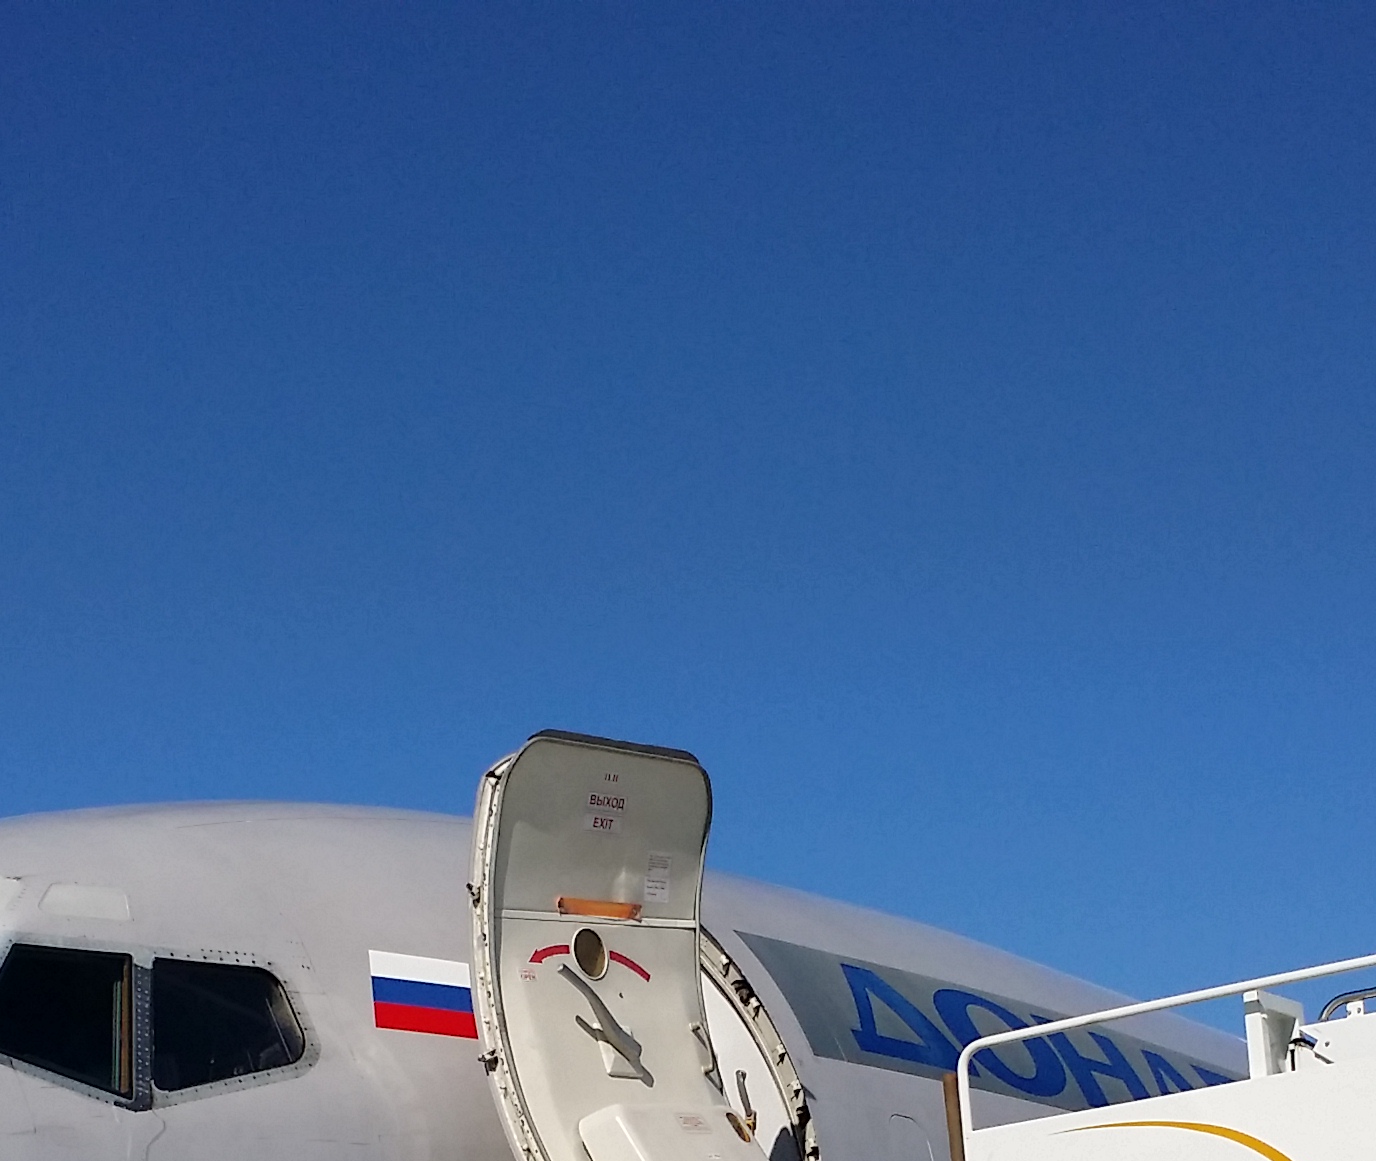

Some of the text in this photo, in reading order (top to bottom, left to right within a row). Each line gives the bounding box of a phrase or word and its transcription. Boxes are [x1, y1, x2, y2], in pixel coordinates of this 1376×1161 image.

[589, 794, 625, 810] ВЫХОД
[592, 817, 614, 830] EXIT
[840, 963, 1233, 1108] ДОНА
